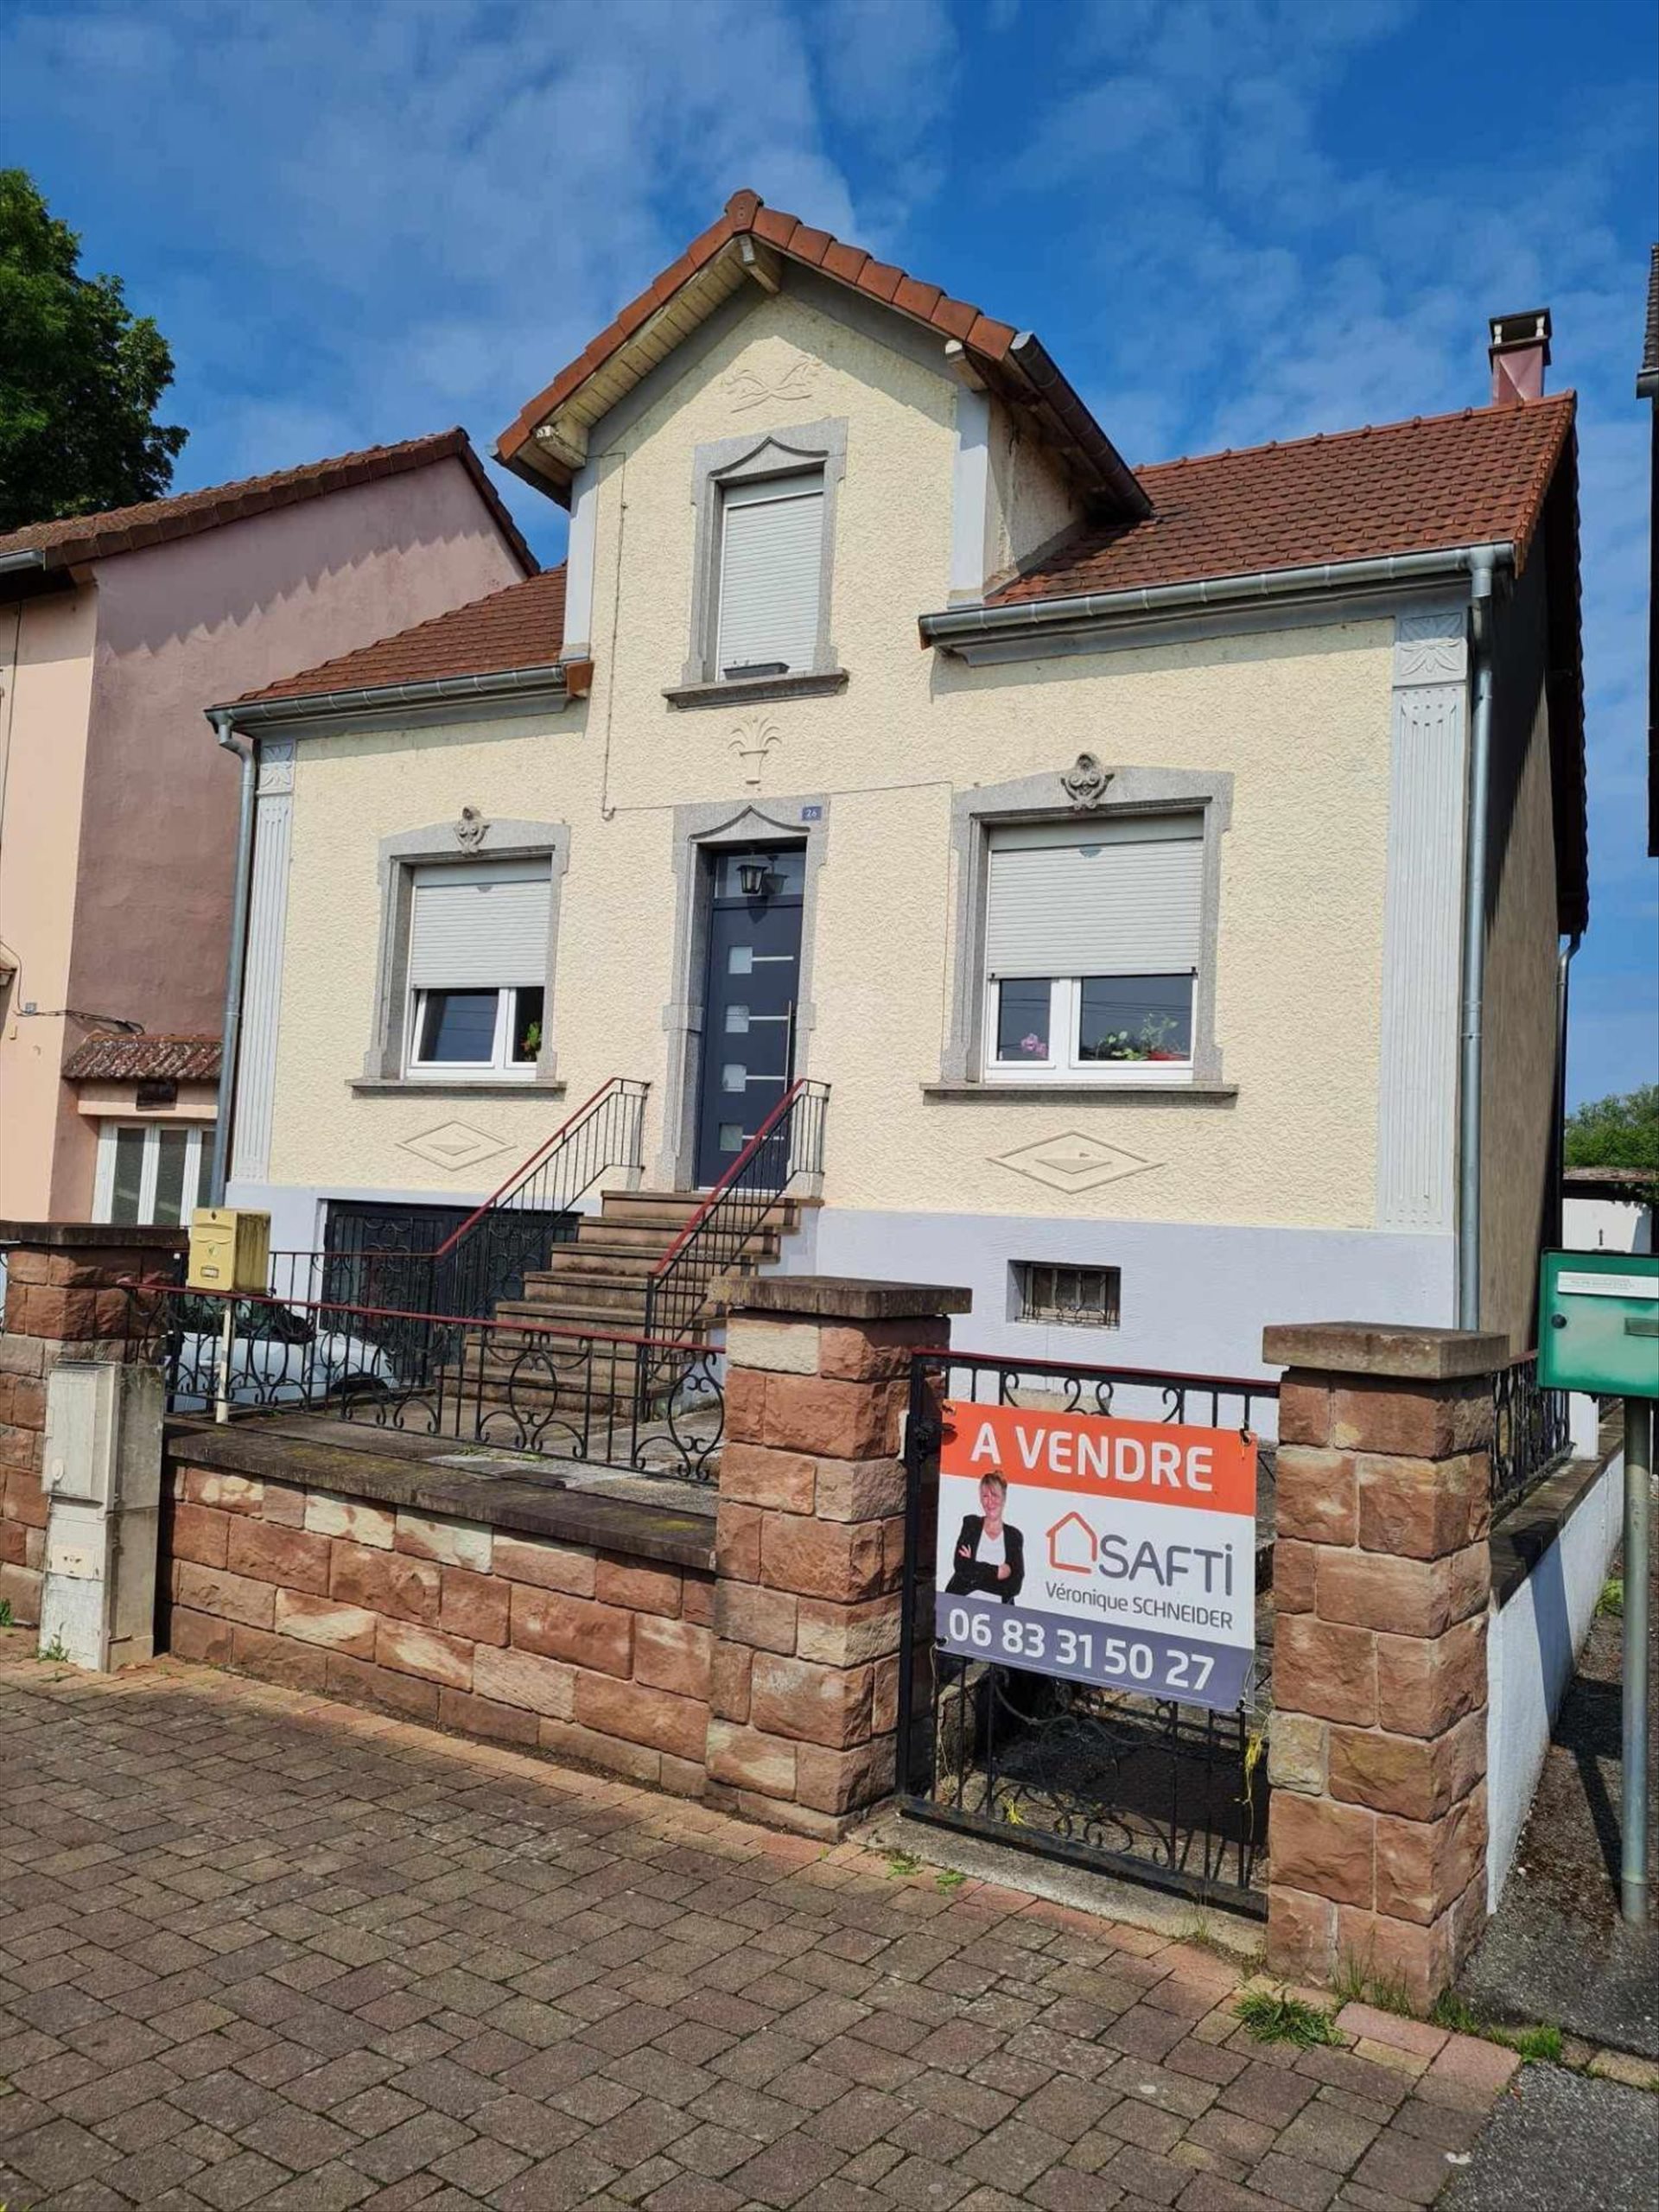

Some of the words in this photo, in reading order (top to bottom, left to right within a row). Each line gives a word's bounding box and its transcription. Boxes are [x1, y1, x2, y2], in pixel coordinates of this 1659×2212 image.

[804, 808, 818, 818] 26
[970, 1422, 1001, 1465] A
[1015, 1426, 1213, 1492] VENDRE
[1045, 1580, 1128, 1613] Véronique
[1133, 1596, 1233, 1630] SCHNEIDER
[949, 1608, 992, 1647] 06
[1002, 1618, 1046, 1659] 83
[1055, 1629, 1092, 1669] 31
[1104, 1637, 1154, 1681] 50
[1166, 1649, 1215, 1691] 27
